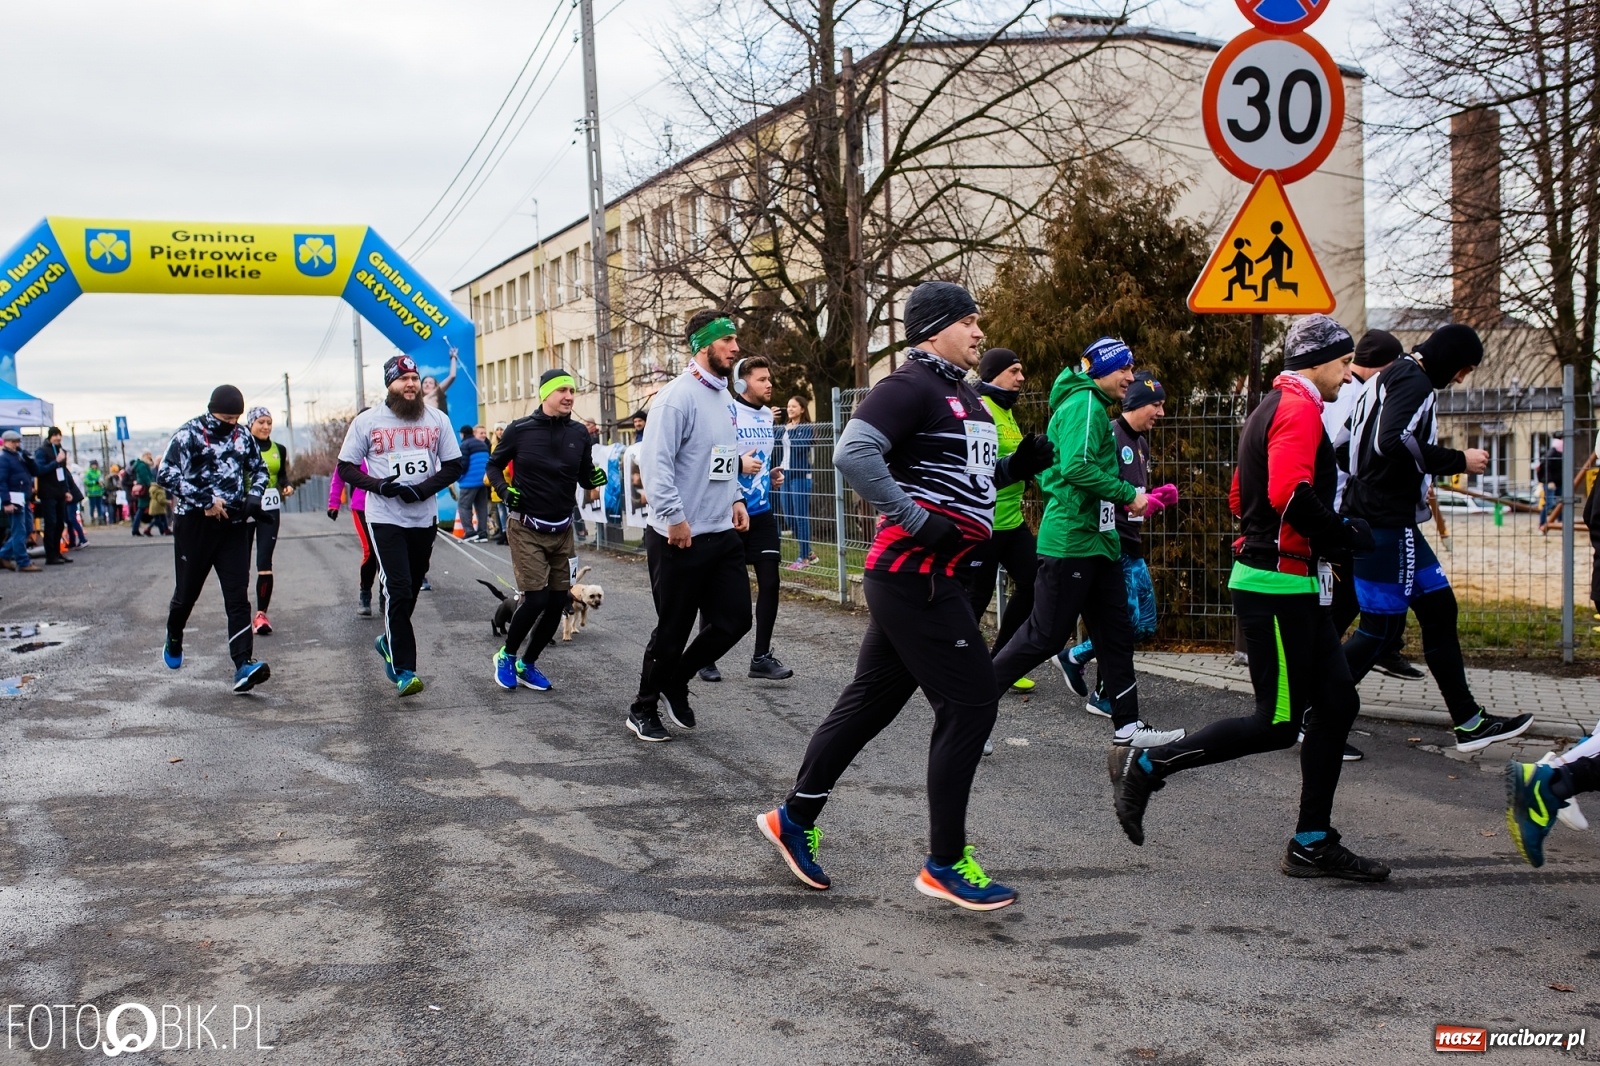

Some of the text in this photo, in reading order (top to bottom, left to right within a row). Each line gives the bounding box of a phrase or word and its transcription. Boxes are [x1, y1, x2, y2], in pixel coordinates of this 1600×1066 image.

[1226, 65, 1323, 145] 30
[171, 230, 255, 243] Gmina
[7, 242, 50, 282] ludzi
[150, 245, 278, 262] Pietrowice
[167, 264, 261, 279] Wielkie
[368, 251, 450, 328] Gmina ludzi
[355, 269, 433, 341] aktywnych
[971, 440, 997, 467] 185
[392, 460, 429, 476] 163
[712, 457, 735, 474] 26
[264, 495, 279, 506] 20
[1404, 527, 1416, 596] RUNNERS
